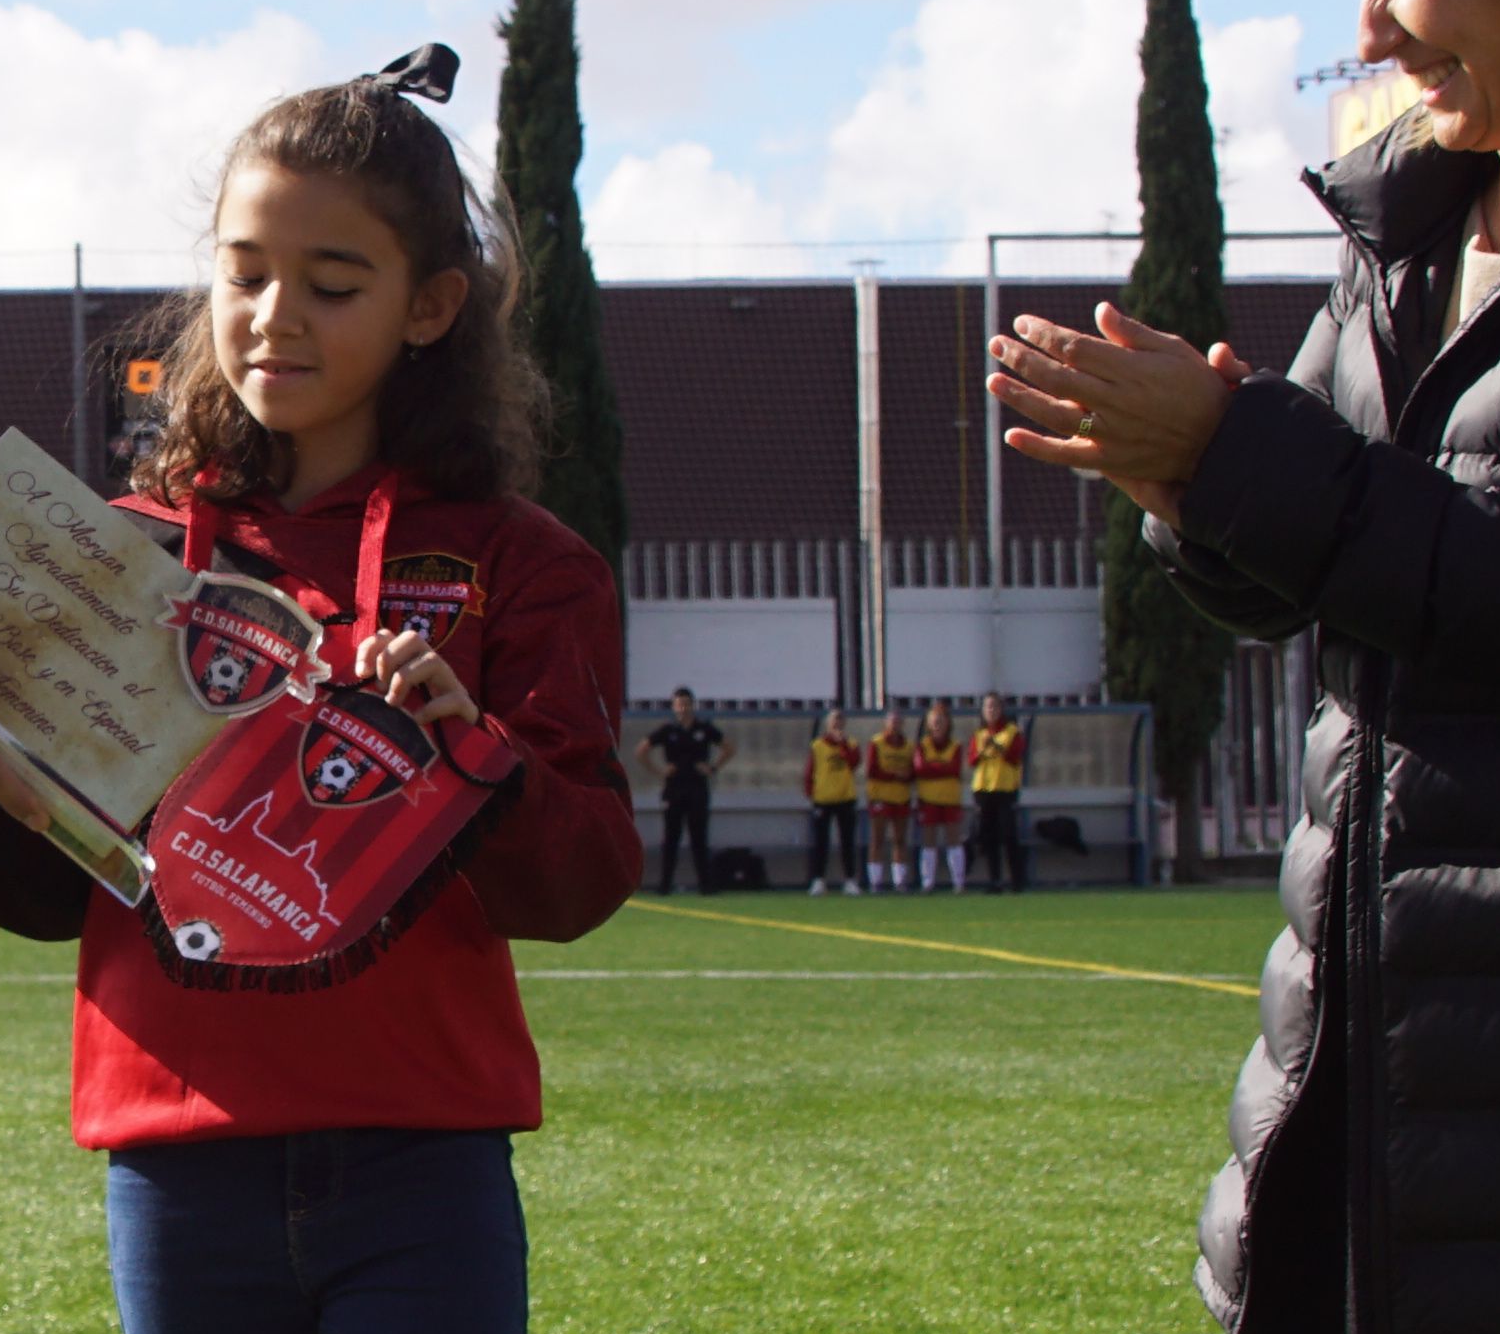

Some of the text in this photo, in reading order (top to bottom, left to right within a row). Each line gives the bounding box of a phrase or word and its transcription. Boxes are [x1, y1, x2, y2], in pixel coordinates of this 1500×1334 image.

[46, 501, 127, 577] Morgan
[5, 522, 142, 636] Agradecimiento
[191, 607, 300, 668] C.D.SALAMANCA
[54, 680, 77, 698] en
[81, 688, 156, 757] Especial
[123, 682, 156, 700] al
[170, 831, 321, 942] C.D.SALAMANCA
[191, 871, 273, 929] FUTBOL FEMENINO
